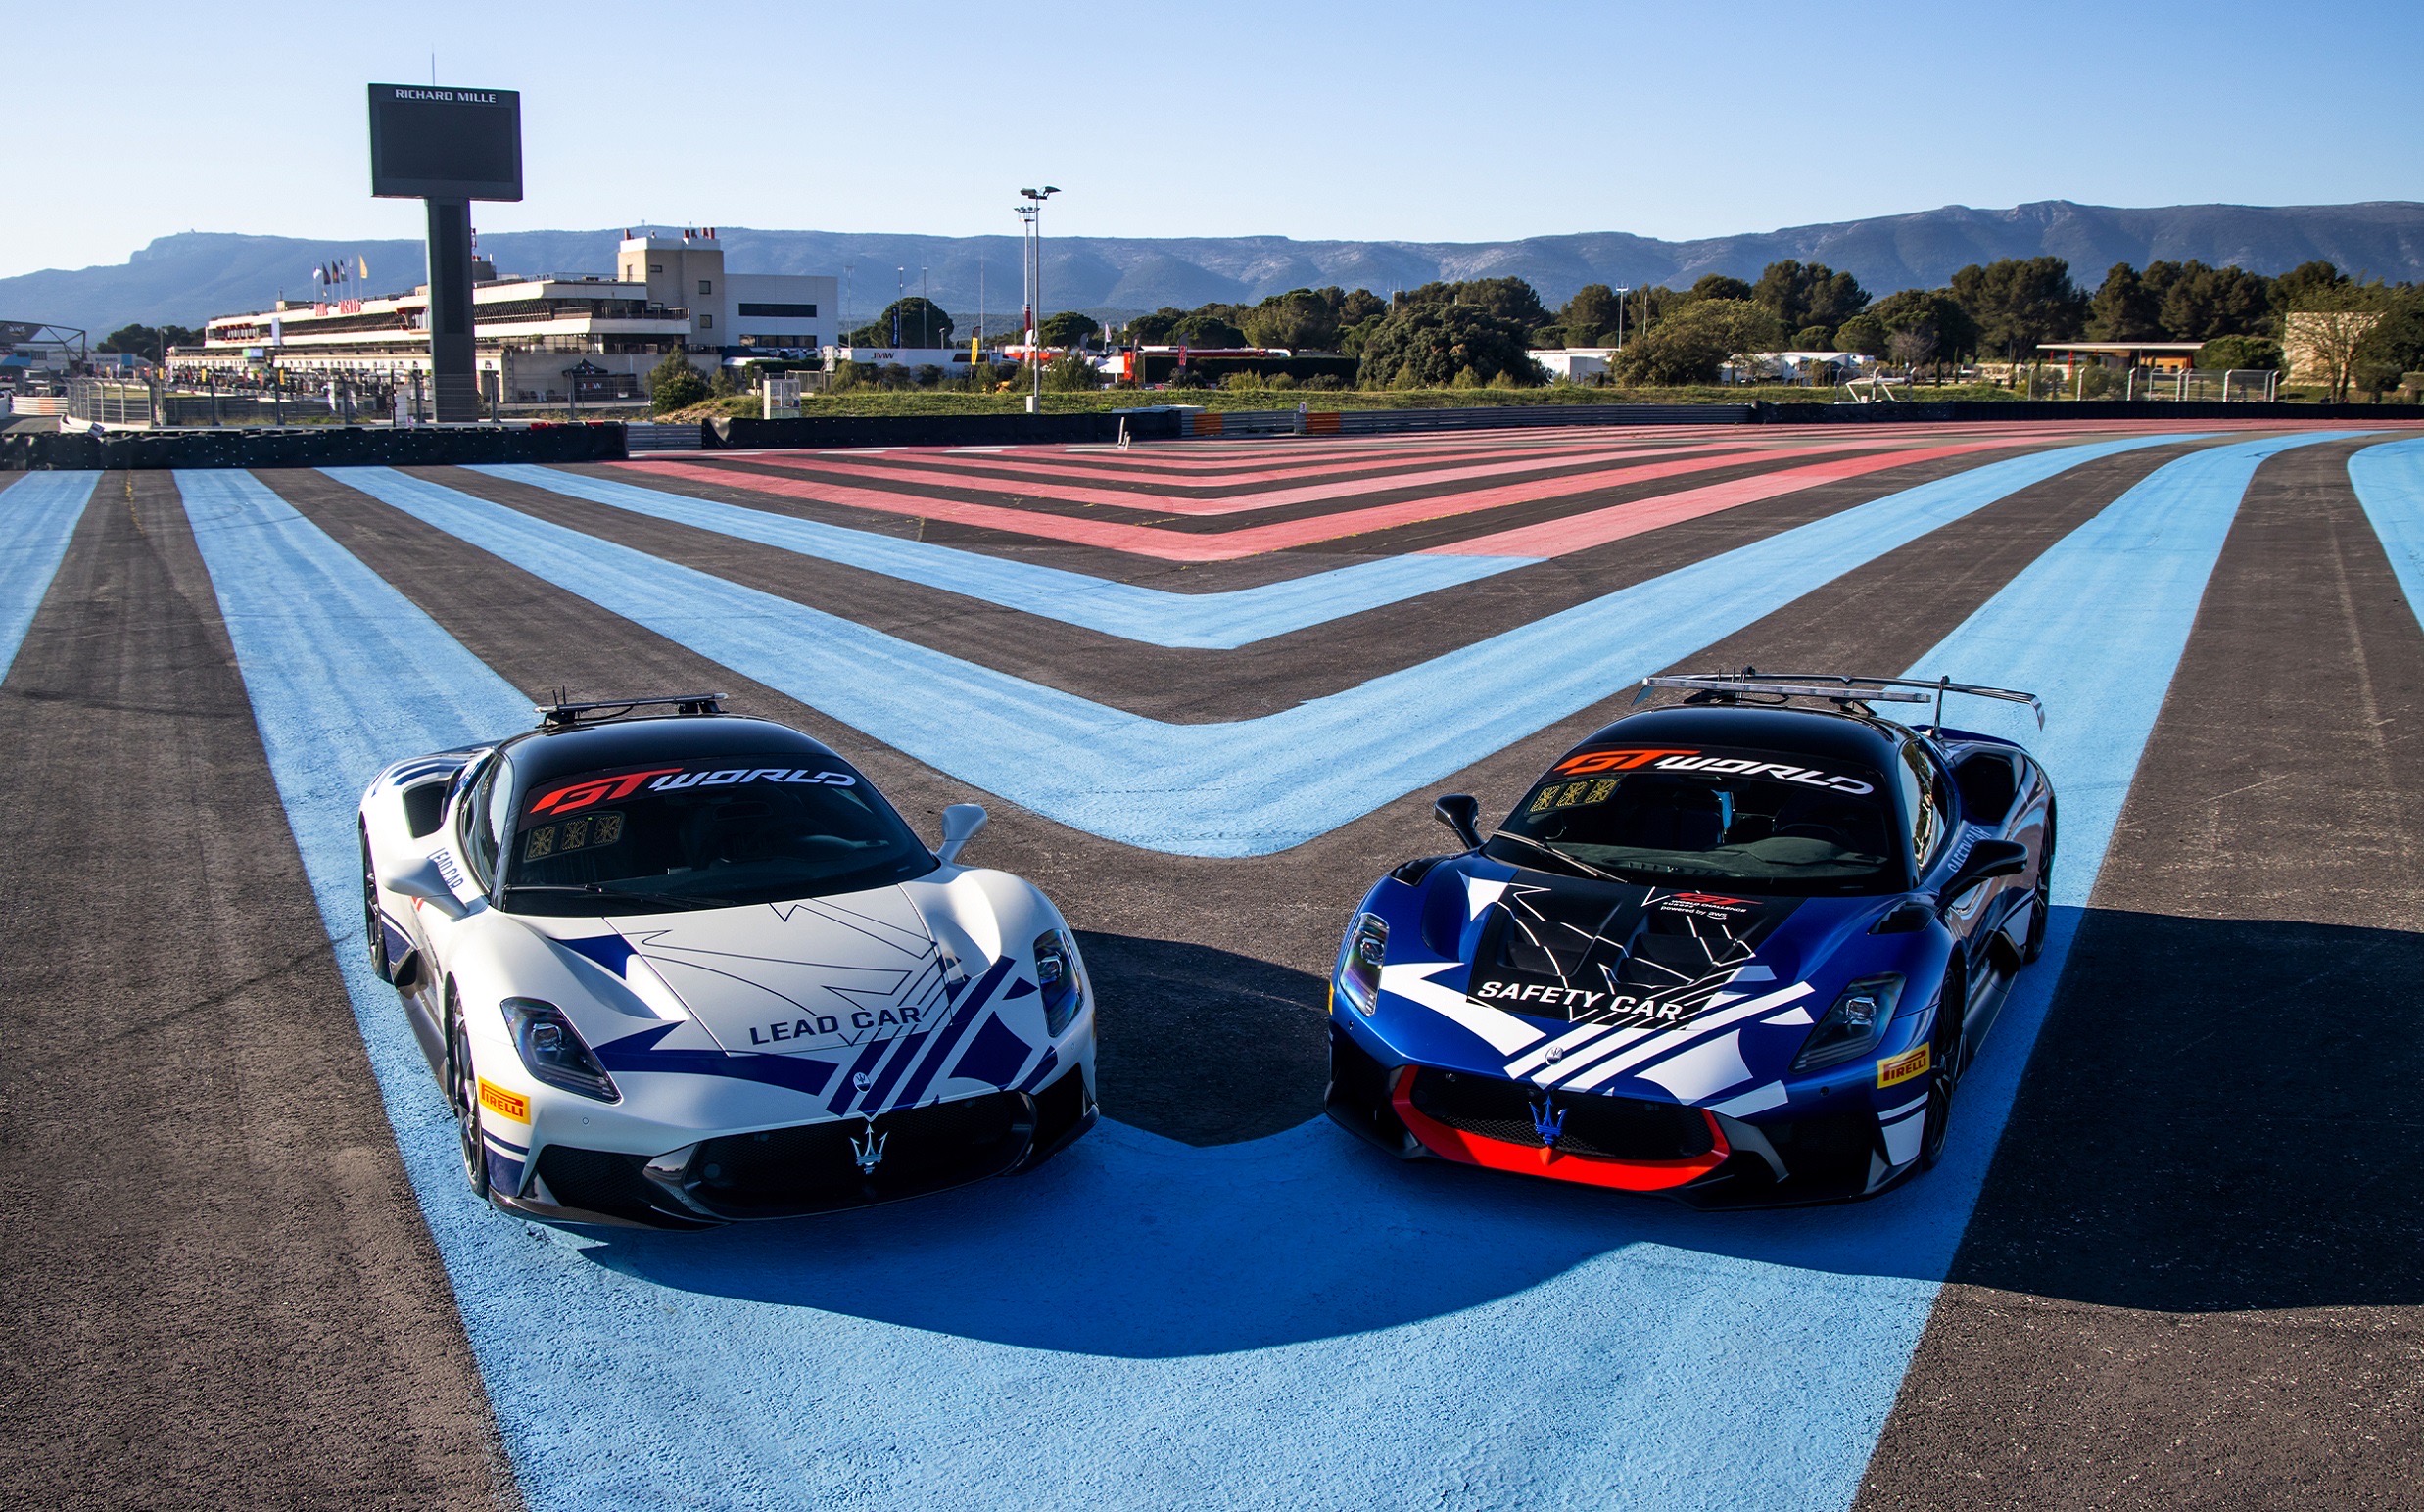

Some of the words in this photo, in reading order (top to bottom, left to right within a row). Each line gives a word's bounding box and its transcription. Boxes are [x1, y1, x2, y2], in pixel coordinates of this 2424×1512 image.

[395, 89, 453, 101] RICHARD
[457, 92, 497, 103] MILLE
[871, 352, 894, 360] JMW
[1553, 749, 1702, 775] GT
[1654, 755, 1875, 795] WORLD
[529, 767, 684, 816] GT
[648, 768, 857, 792] WORLD
[1660, 905, 1695, 914] powered
[1707, 911, 1728, 920] aws
[1701, 903, 1747, 913] CHALLENGE
[1477, 981, 1605, 1008] SAFETY
[1609, 995, 1684, 1021] CAR
[749, 1016, 839, 1045] LEAD
[850, 1006, 923, 1030] CAR
[1883, 1050, 1926, 1081] PIRELLI
[481, 1082, 524, 1117] PIRELLI
